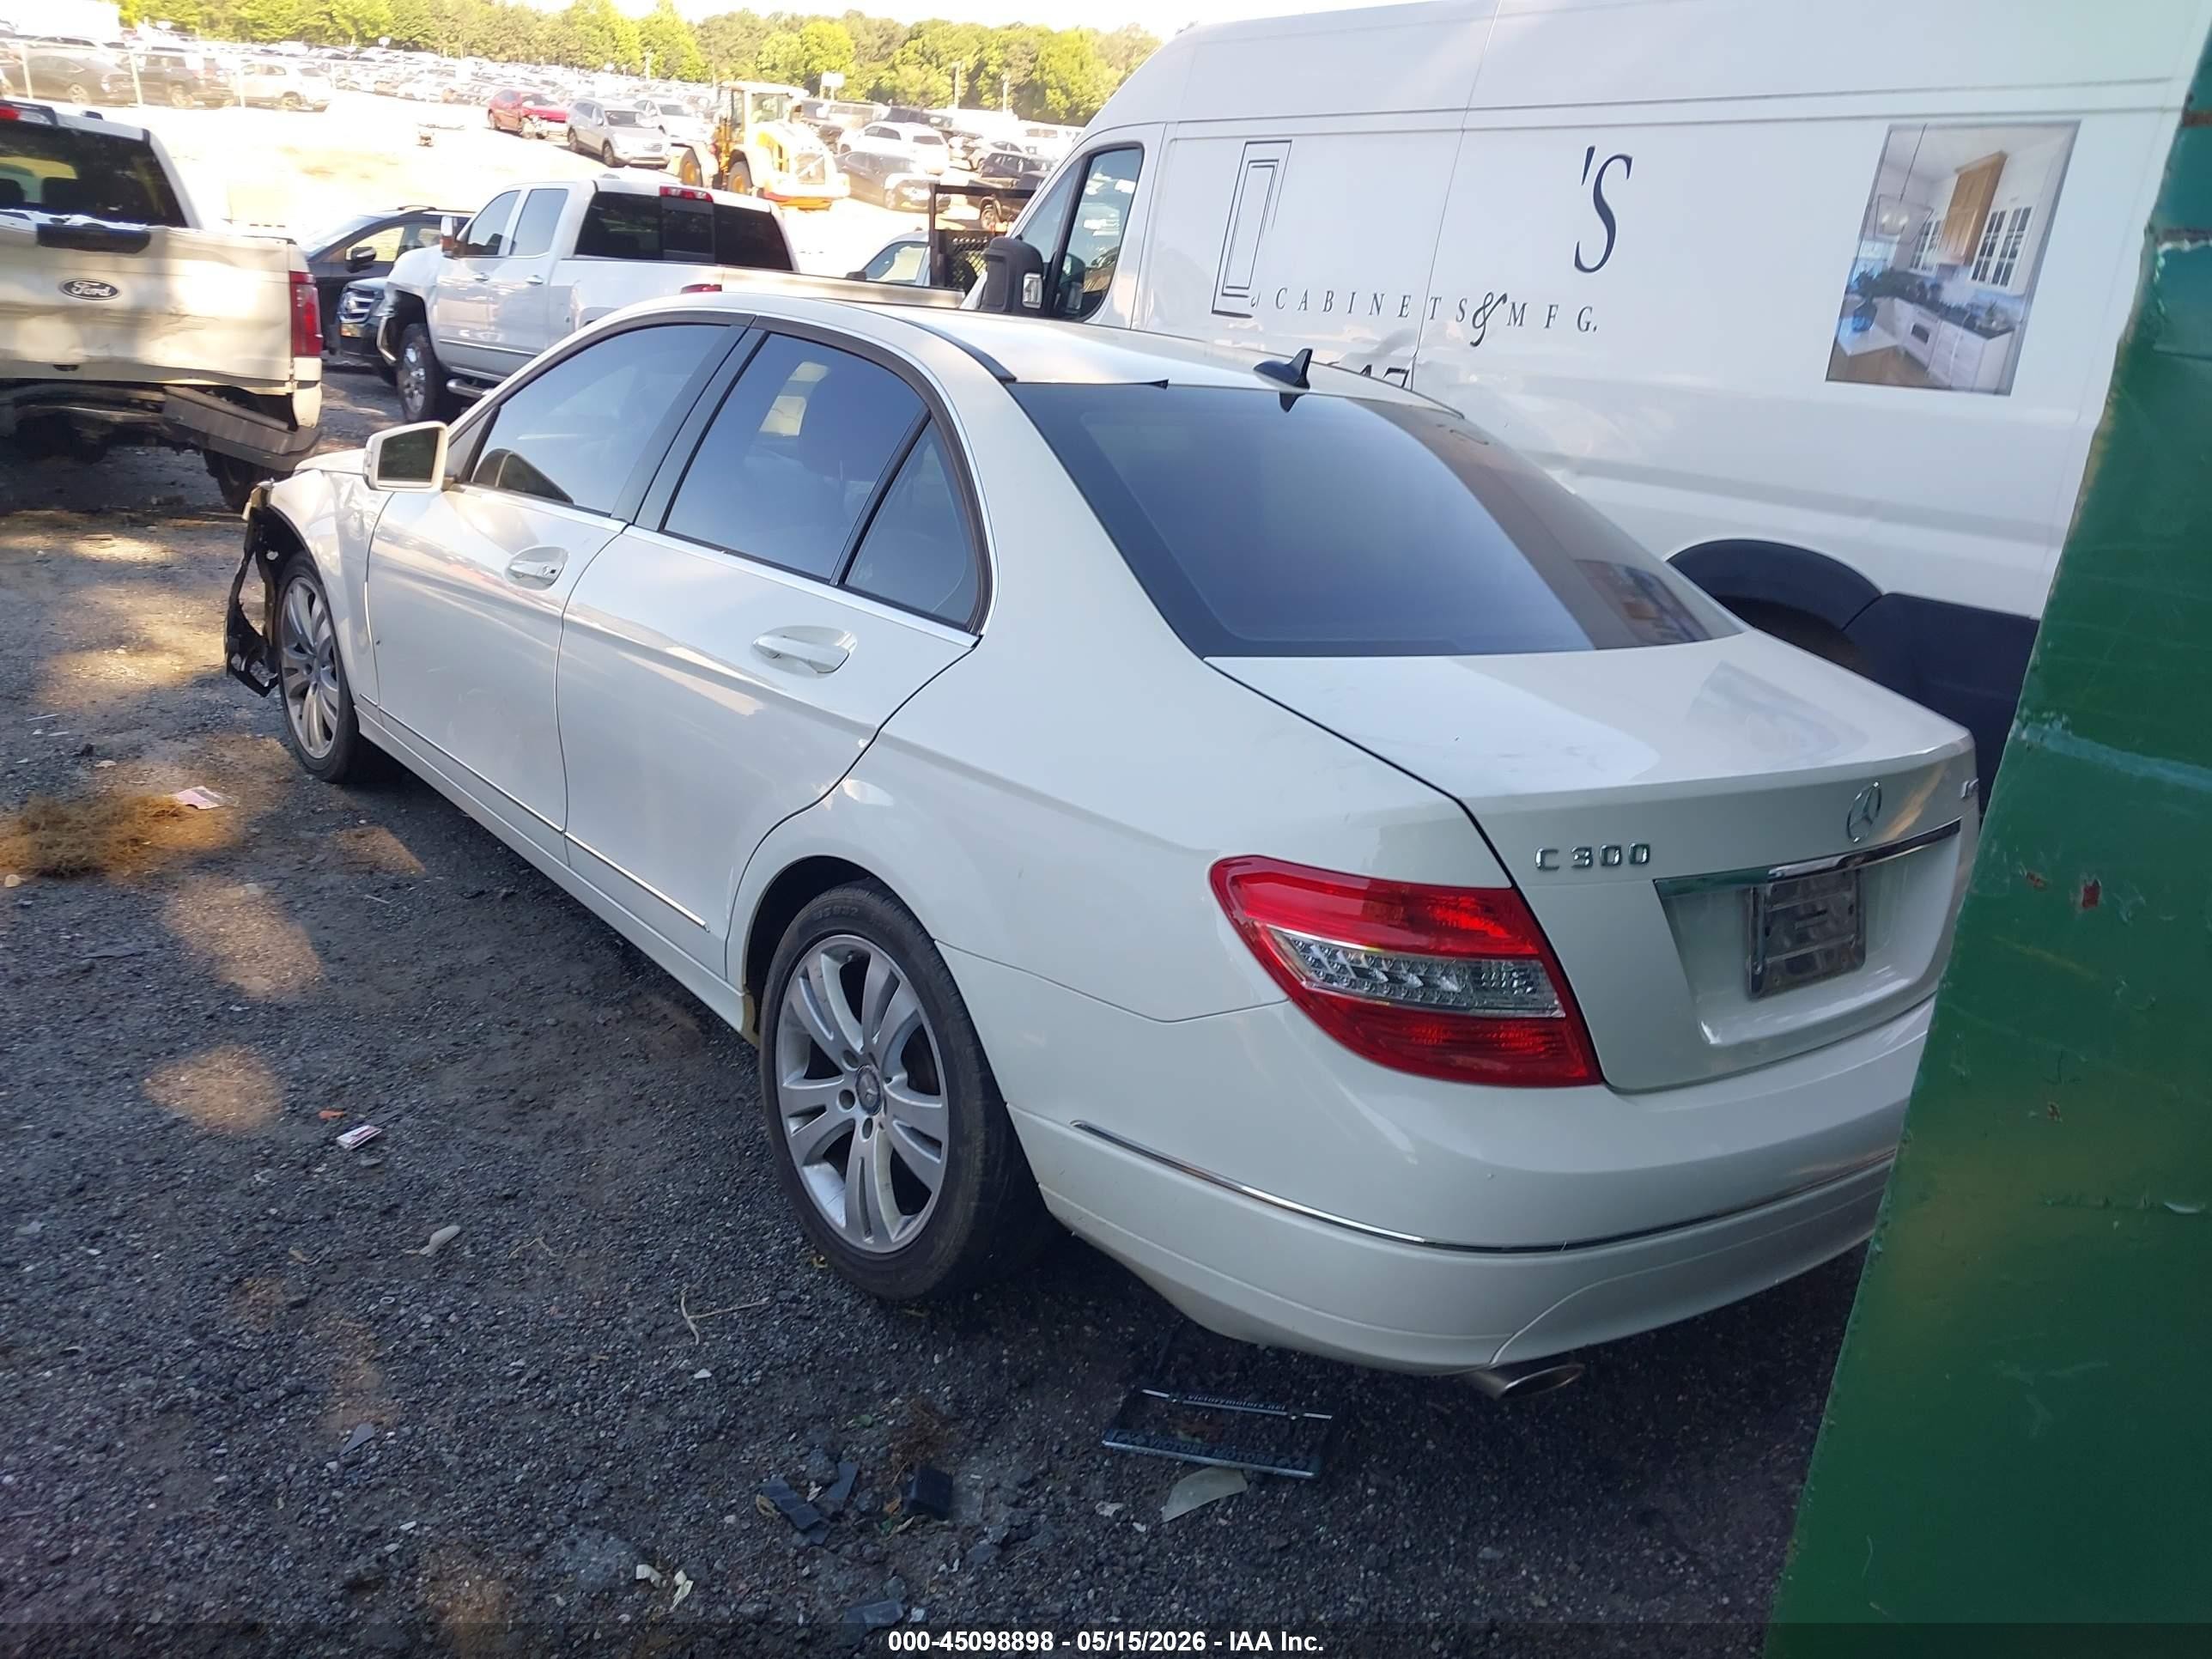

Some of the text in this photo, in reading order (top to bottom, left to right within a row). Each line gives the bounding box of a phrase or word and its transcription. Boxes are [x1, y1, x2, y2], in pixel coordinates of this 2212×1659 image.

[1574, 145, 1633, 274] 'S
[1275, 287, 1468, 323] CABINETS
[1469, 291, 1508, 347] &
[1506, 301, 1597, 332] MFG.
